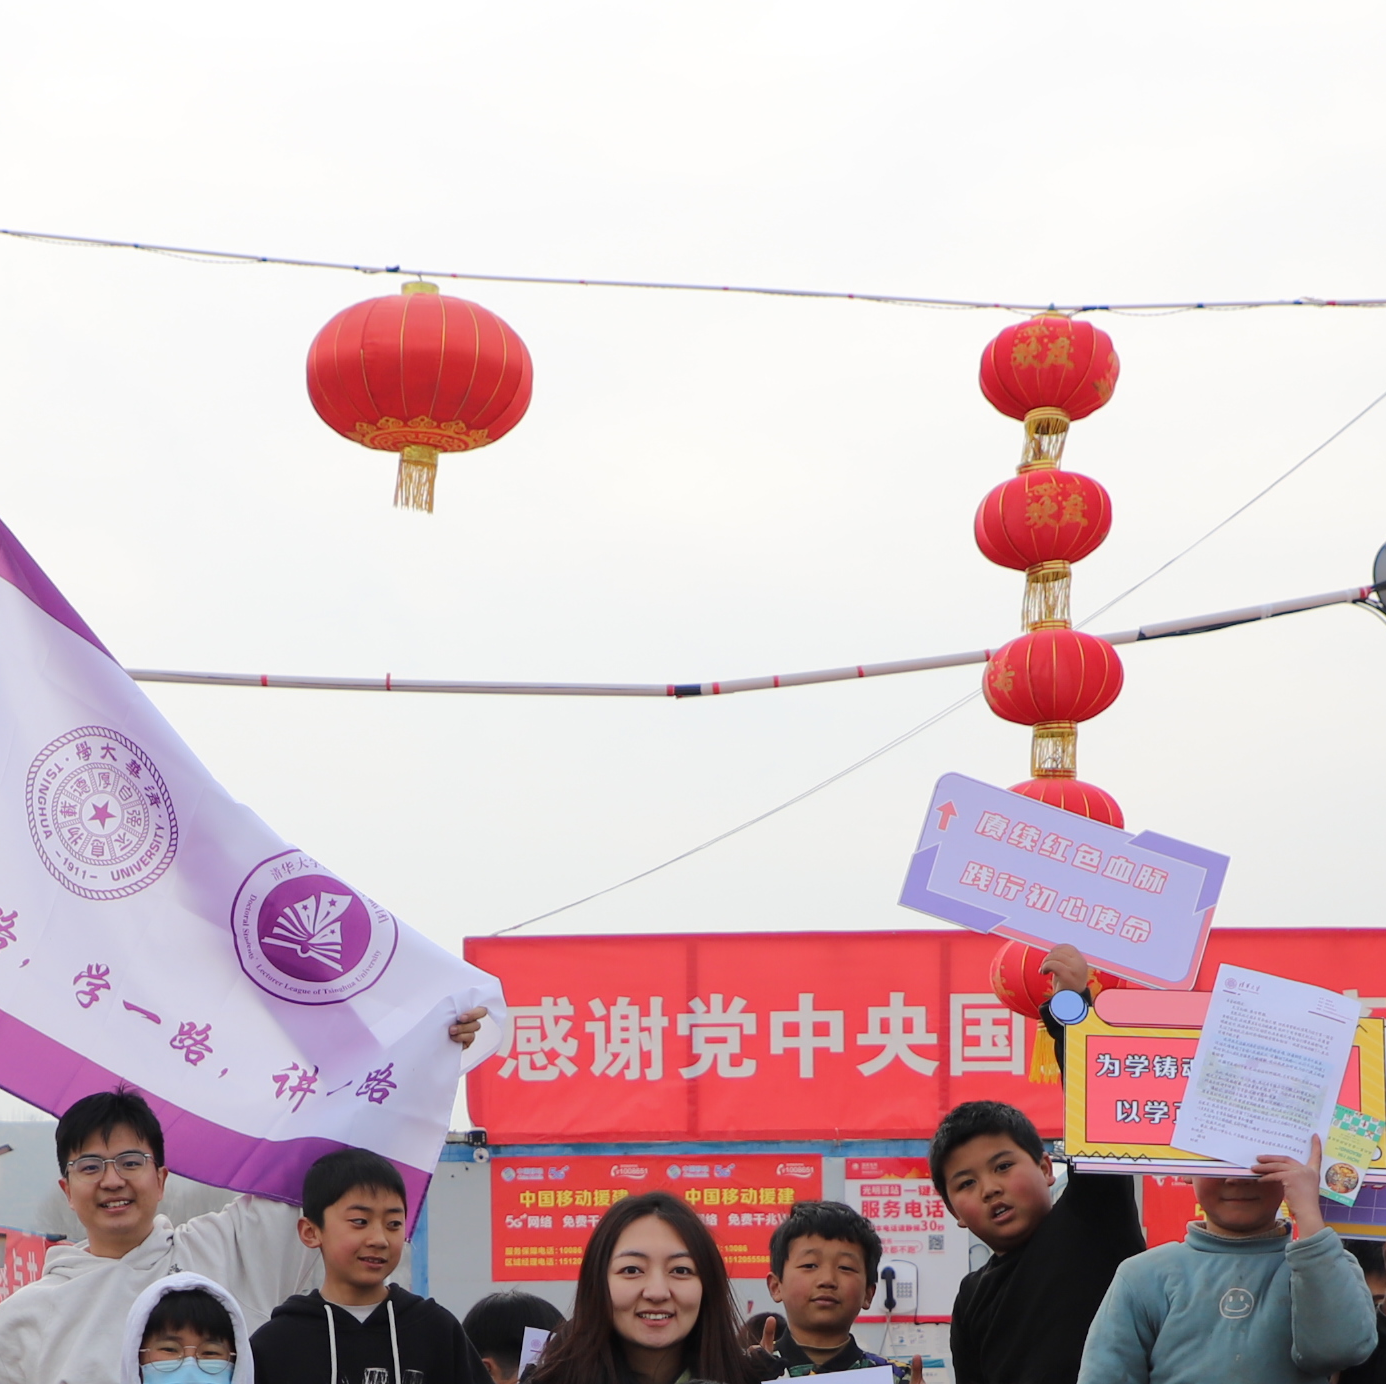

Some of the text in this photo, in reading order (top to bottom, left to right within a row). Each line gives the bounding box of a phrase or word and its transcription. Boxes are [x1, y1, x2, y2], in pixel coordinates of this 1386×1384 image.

[38, 763, 65, 840] TSINGHUA
[110, 822, 165, 882] UNIVERSITY
[974, 811, 1169, 894] 赓续红色血脉
[960, 861, 1153, 943] 践行初心使命
[284, 983, 311, 995] League
[322, 981, 356, 995] Tsinghua
[355, 949, 382, 983] University
[562, 1213, 600, 1228] 免费千
[685, 1187, 796, 1205] 中国移动援建
[861, 1200, 945, 1219] 服务电话
